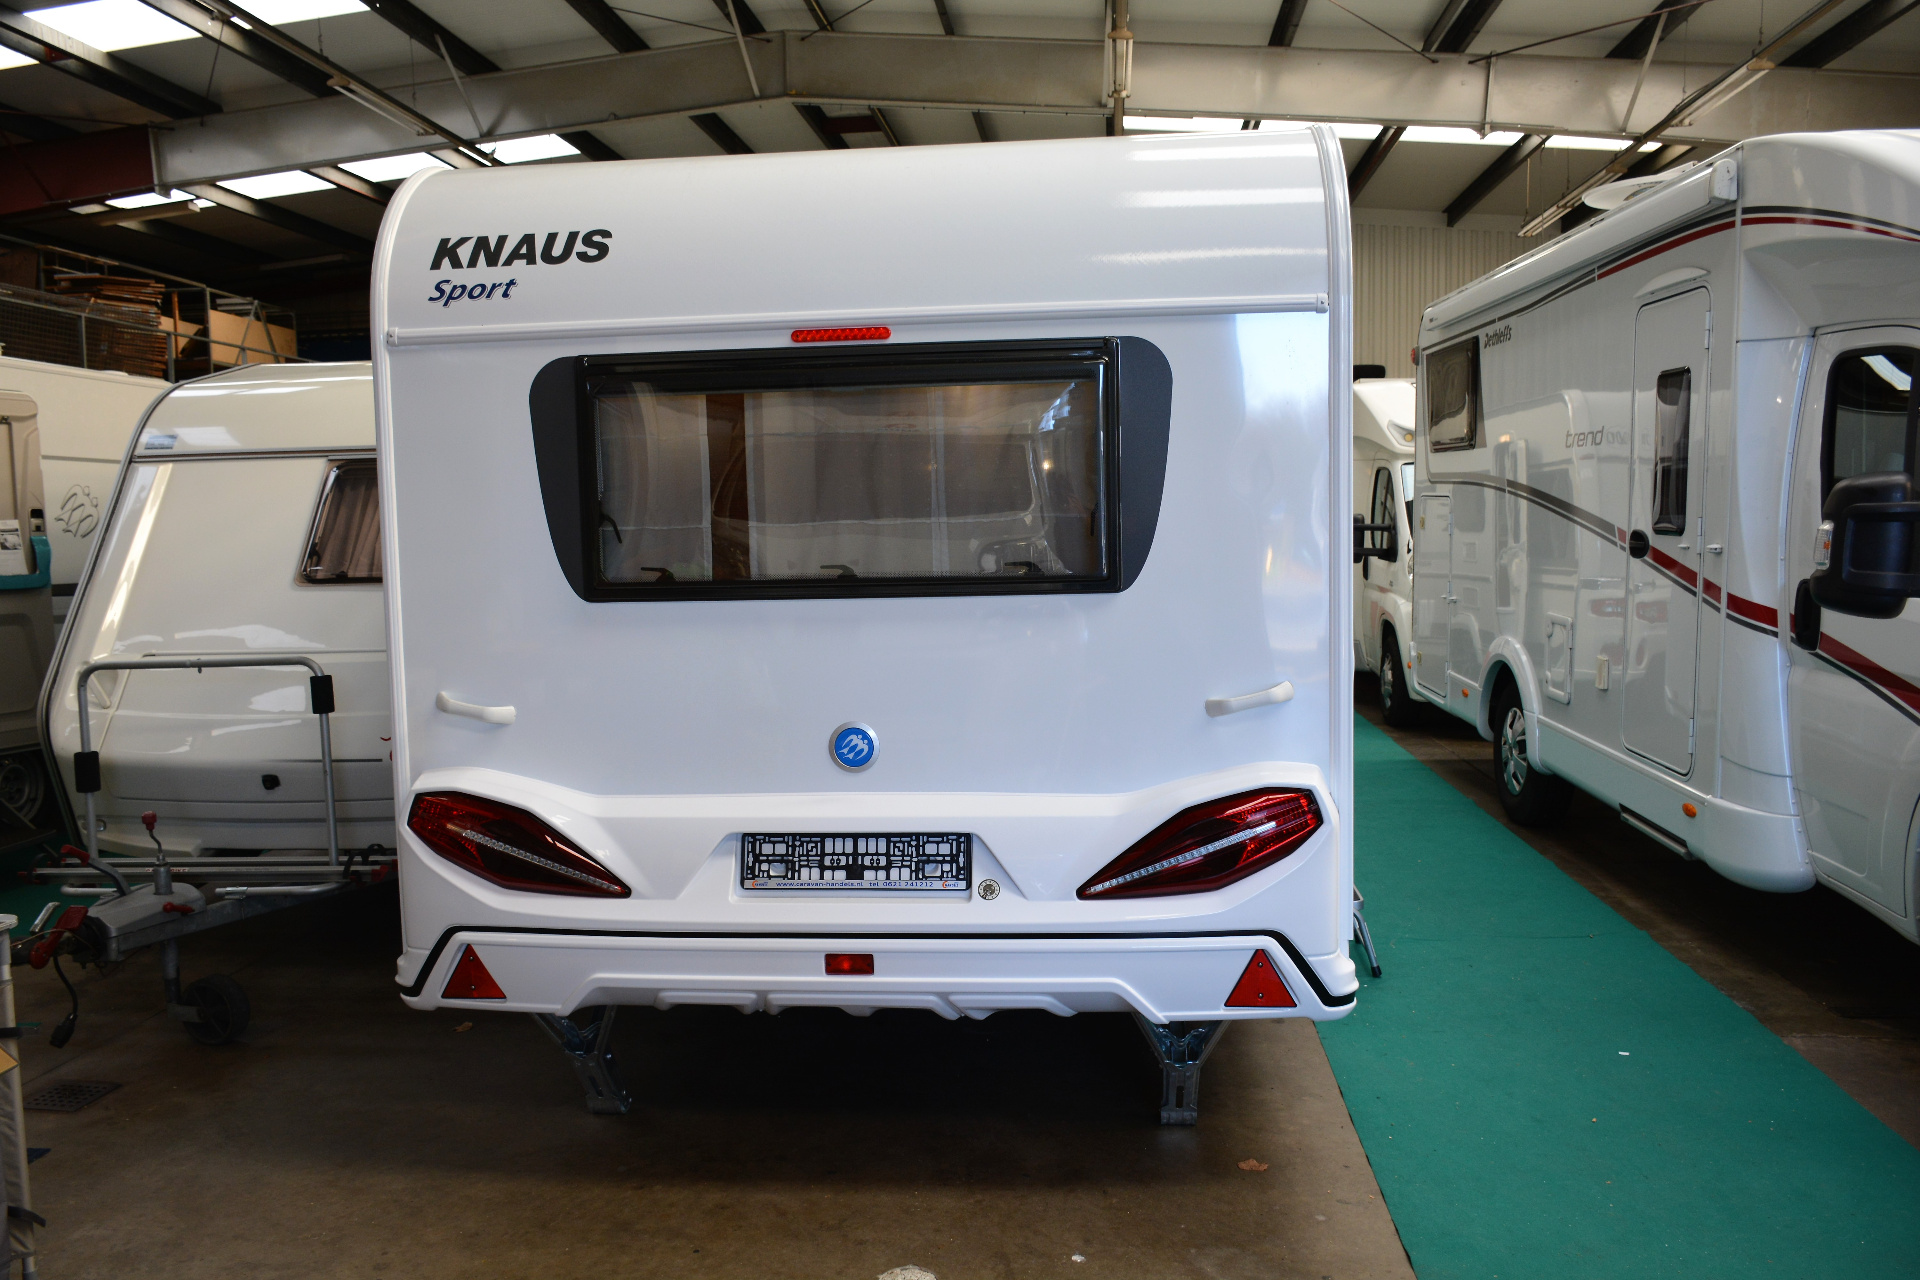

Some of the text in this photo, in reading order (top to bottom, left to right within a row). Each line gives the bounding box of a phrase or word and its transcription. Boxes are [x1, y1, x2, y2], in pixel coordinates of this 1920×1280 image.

[429, 228, 613, 271] KNAUS
[427, 278, 518, 309] Sport
[1483, 325, 1512, 349] Dethleffs
[1564, 425, 1605, 449] trend
